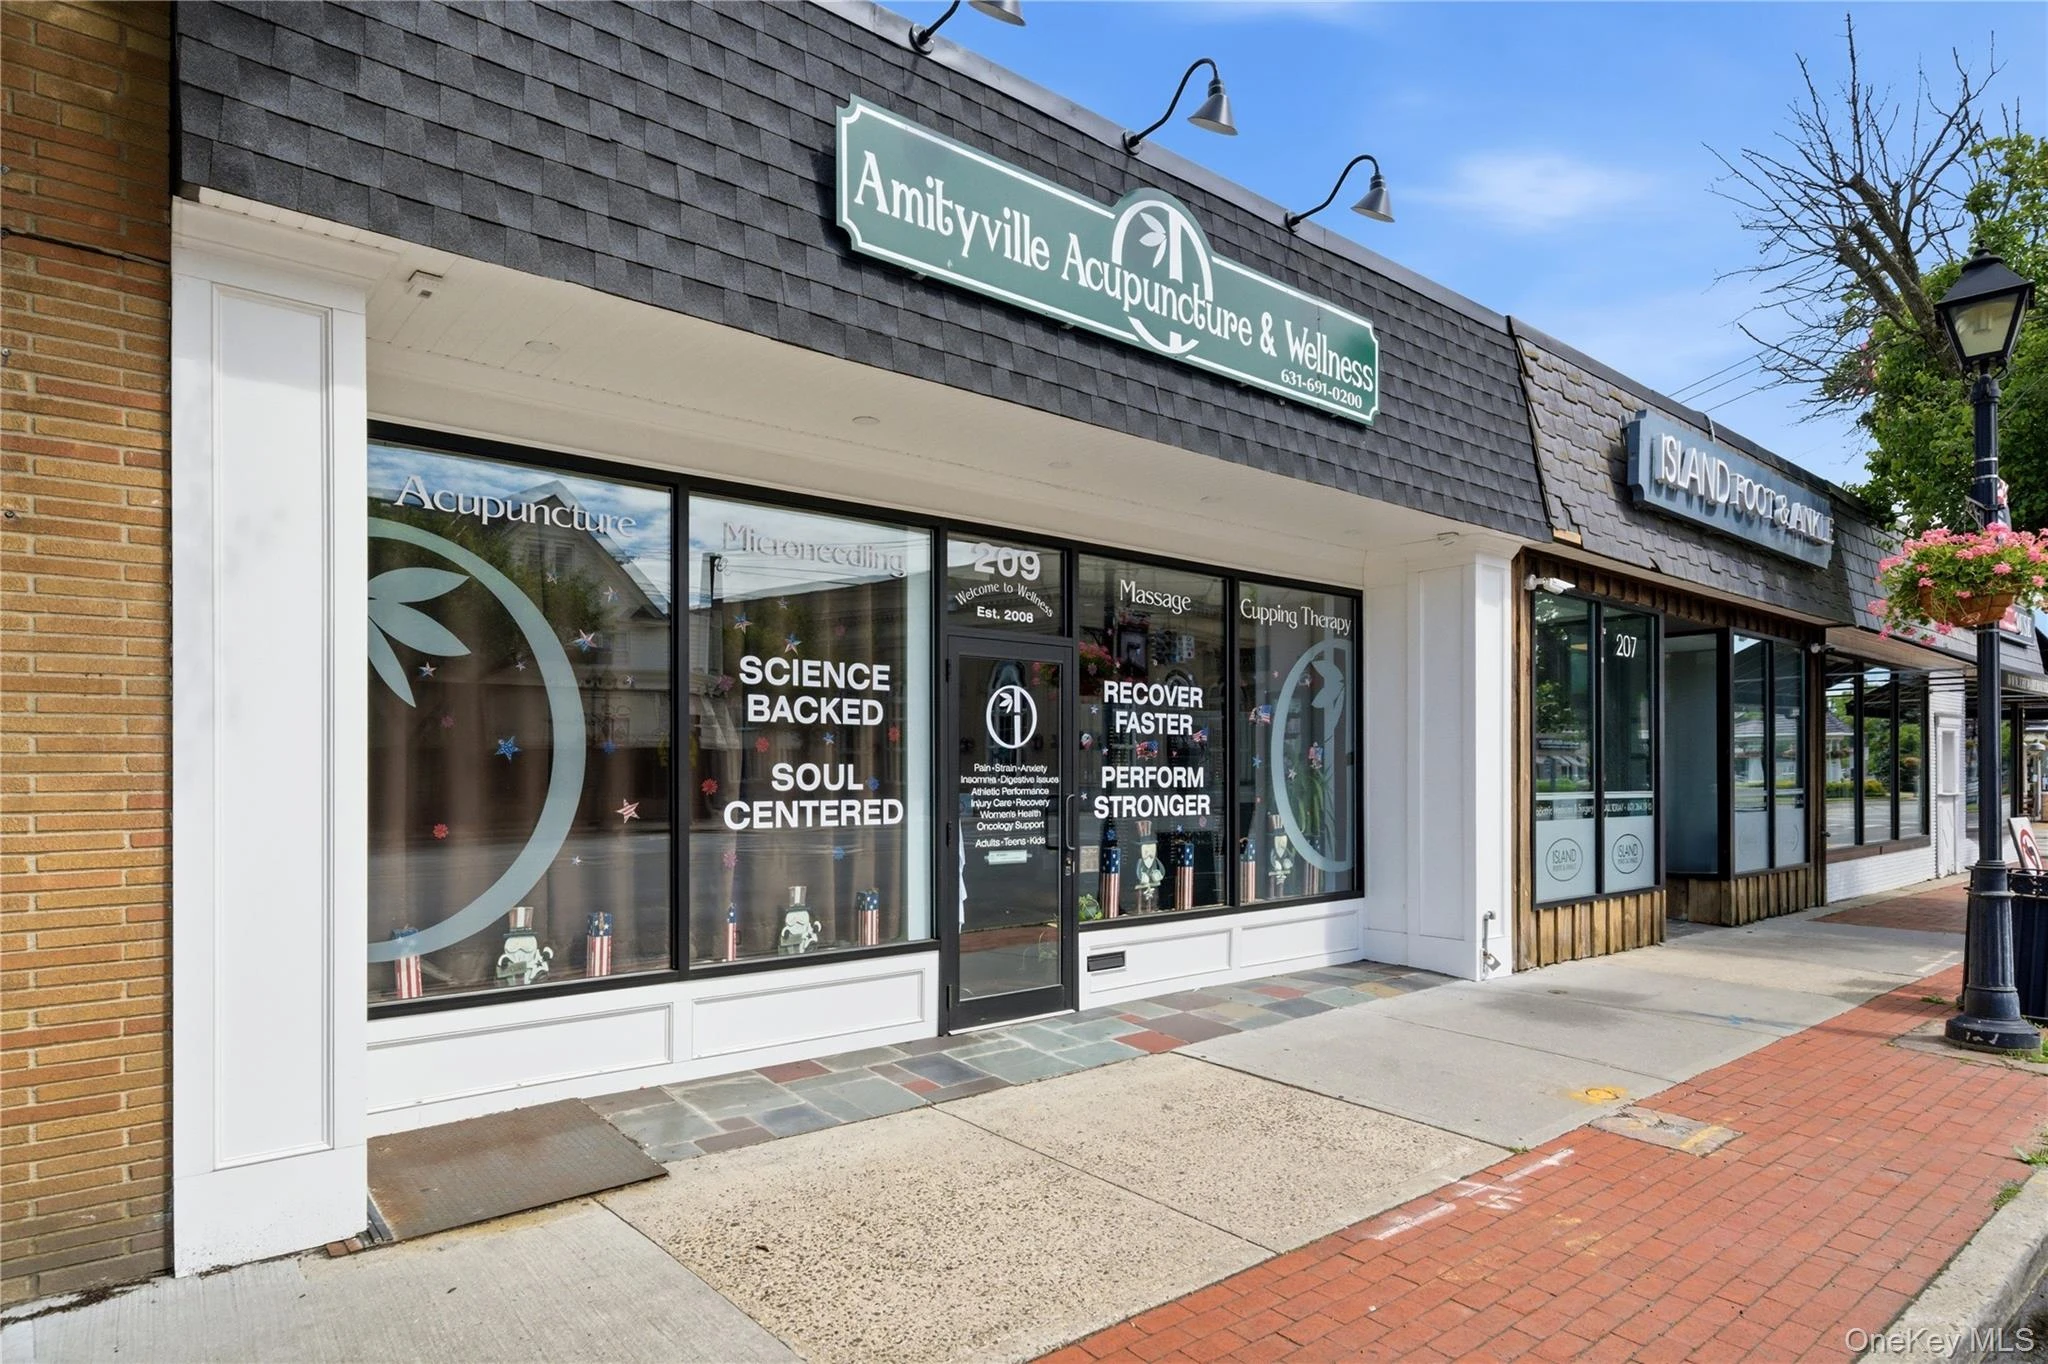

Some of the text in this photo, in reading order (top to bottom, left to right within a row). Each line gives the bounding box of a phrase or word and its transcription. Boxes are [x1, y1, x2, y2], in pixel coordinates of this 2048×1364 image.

[854, 150, 1374, 392] Amityville Acupuncture & Wellness
[1281, 368, 1362, 409] 631-691-0200
[1655, 433, 1730, 504] ISLAND
[1730, 473, 1776, 519] FOOT
[1774, 494, 1790, 527] &
[393, 474, 637, 537] Acupuncture
[722, 521, 905, 577] Microneedling
[973, 542, 1041, 581] 209
[955, 582, 1054, 618] Welcome to Wellness
[1119, 579, 1192, 615] Massage
[976, 605, 1034, 623] Est. 2008
[1240, 598, 1352, 636] Cupping Therapy
[1616, 633, 1637, 658] 207
[739, 655, 891, 692] SCIENCE
[747, 694, 884, 726] BACKED
[1103, 680, 1204, 709] RECOVER
[1115, 711, 1193, 736] FASTER
[771, 762, 864, 792] SOUL
[971, 787, 1050, 796] Athletic Performance
[1101, 766, 1204, 789] PERFORM
[723, 798, 904, 830] CENTERED
[1017, 809, 1042, 818] Health
[1094, 794, 1211, 820] STRONGER
[976, 820, 1045, 831] Oncology Support
